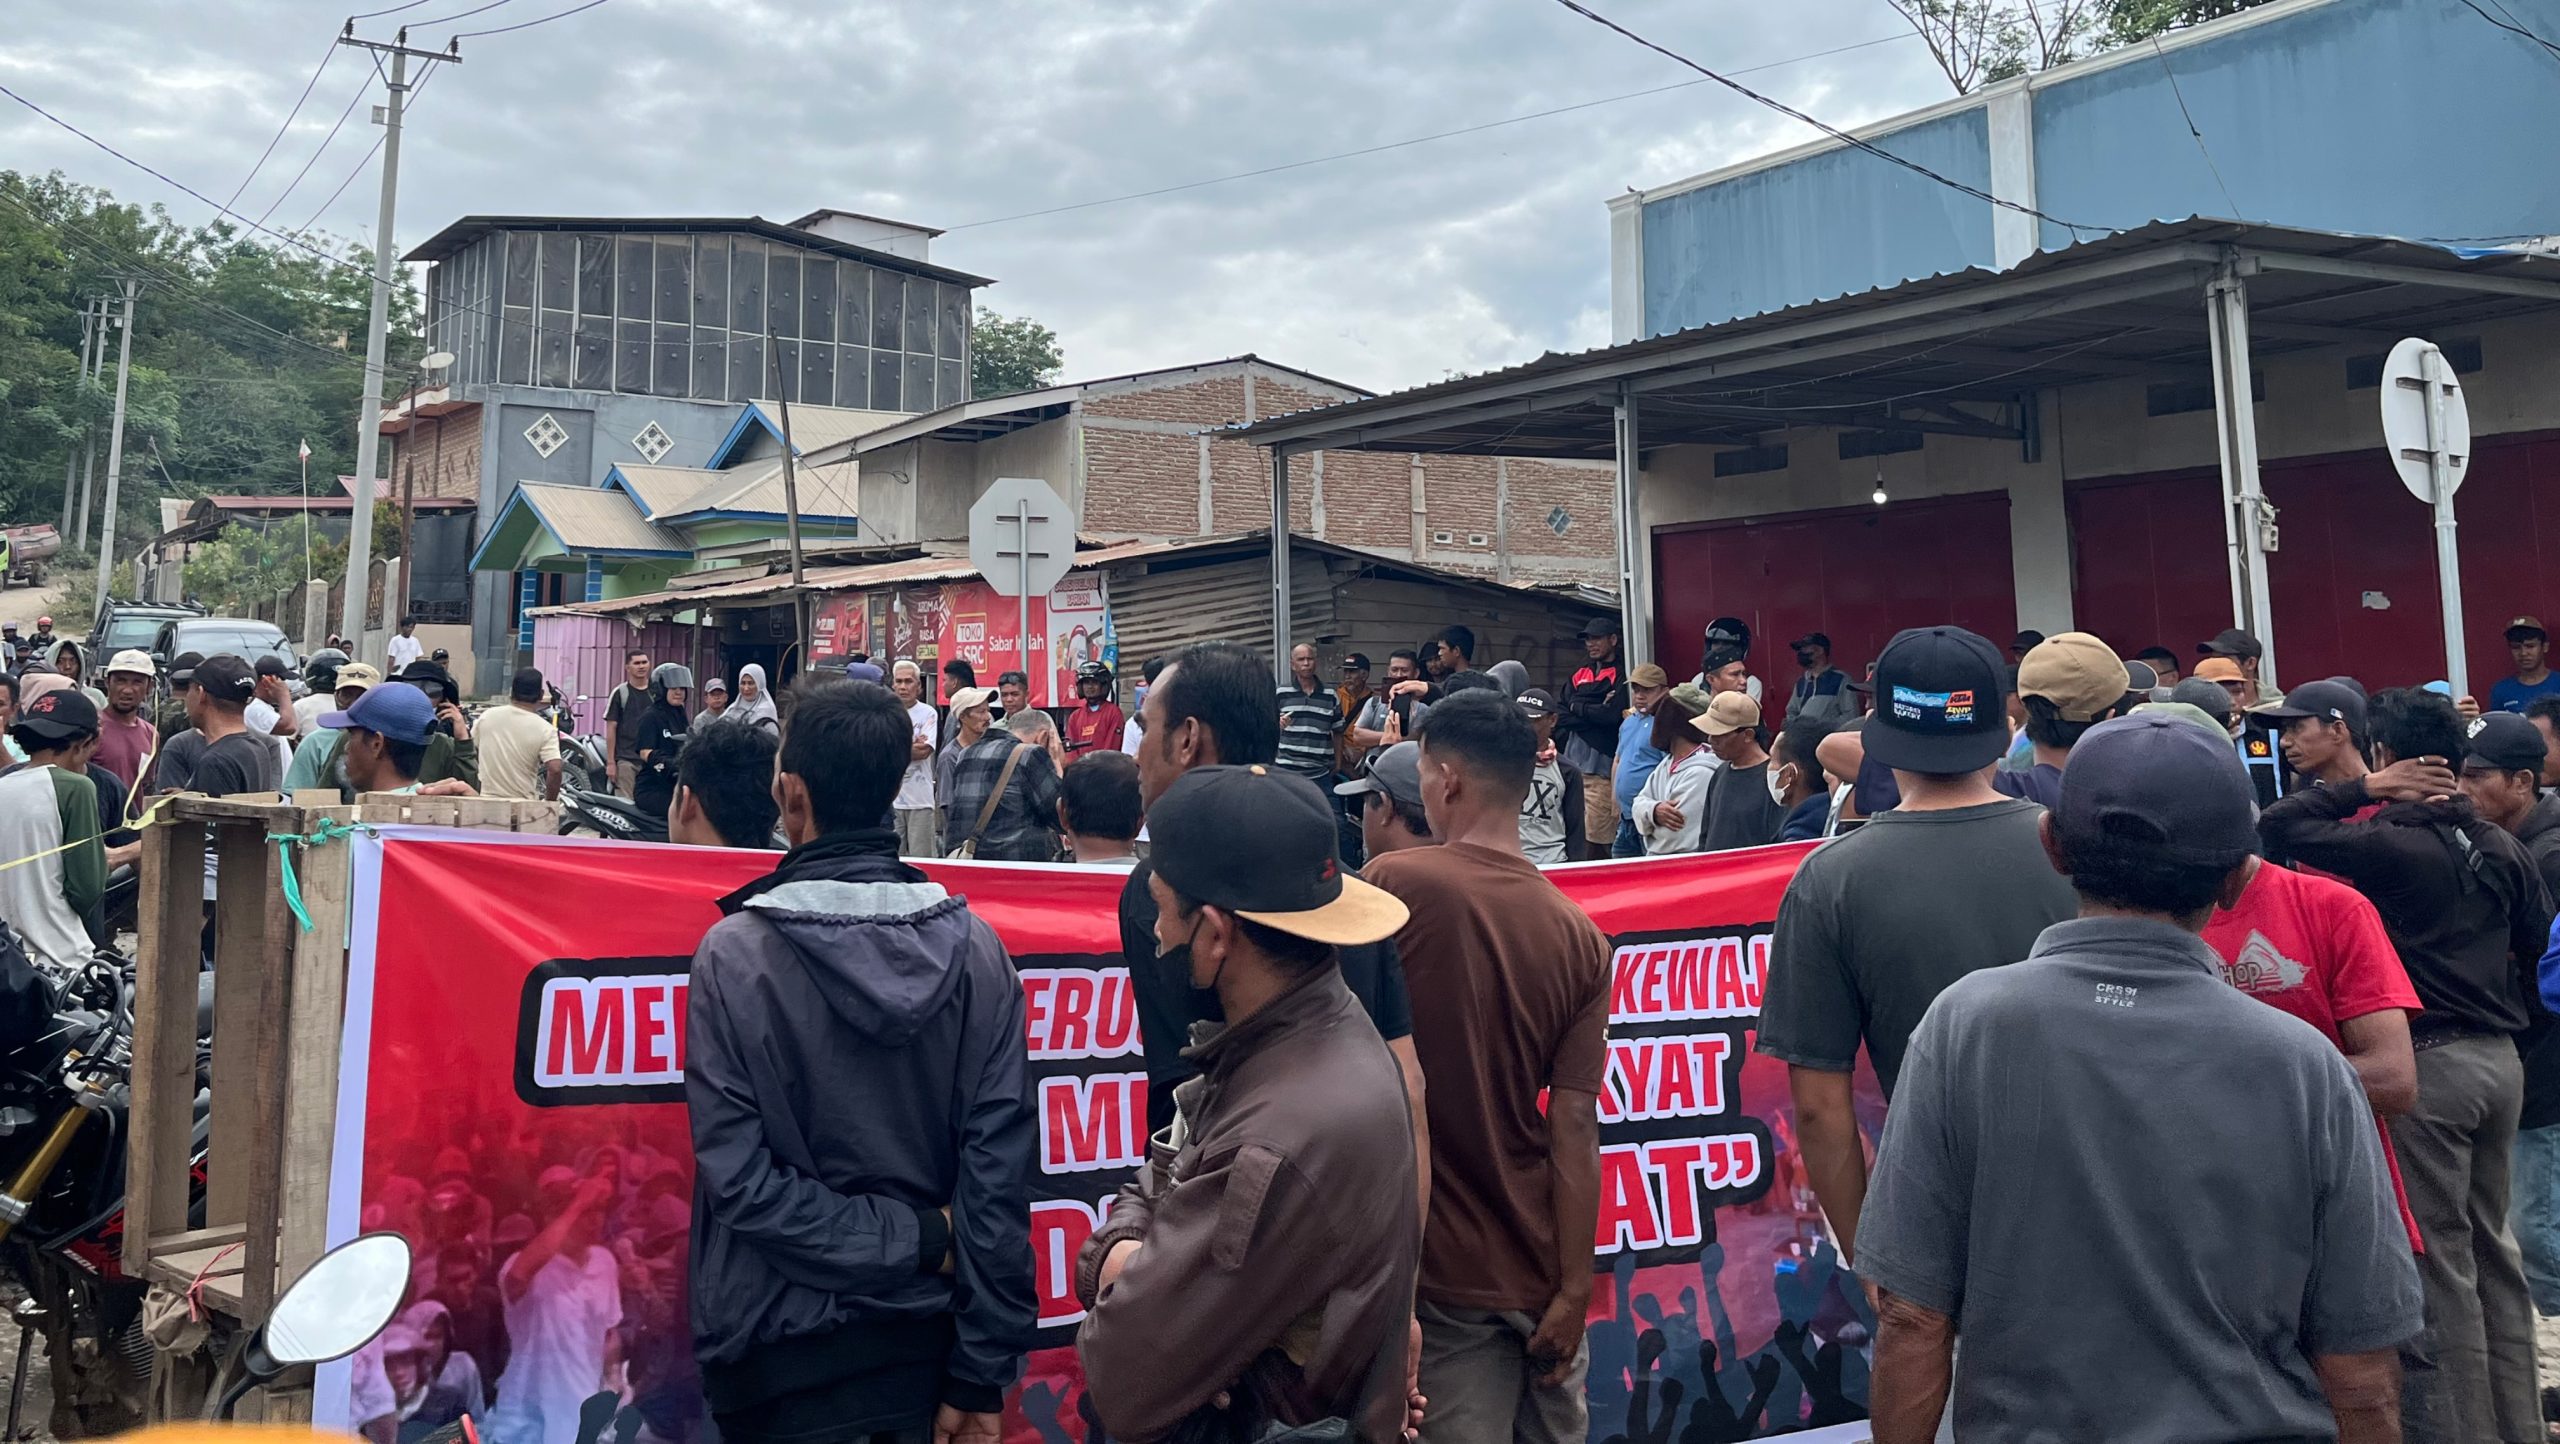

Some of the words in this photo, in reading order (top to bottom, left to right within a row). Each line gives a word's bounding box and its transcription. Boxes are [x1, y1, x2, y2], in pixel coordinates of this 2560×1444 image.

[960, 625, 982, 641] TOKO
[989, 635, 1013, 652] Sabar
[964, 645, 984, 664] SRC
[2217, 961, 2263, 991] HOP
[1022, 975, 1144, 1051] ERU
[1608, 942, 1769, 1016] KEWAJ
[1594, 1140, 1754, 1247] AT”
